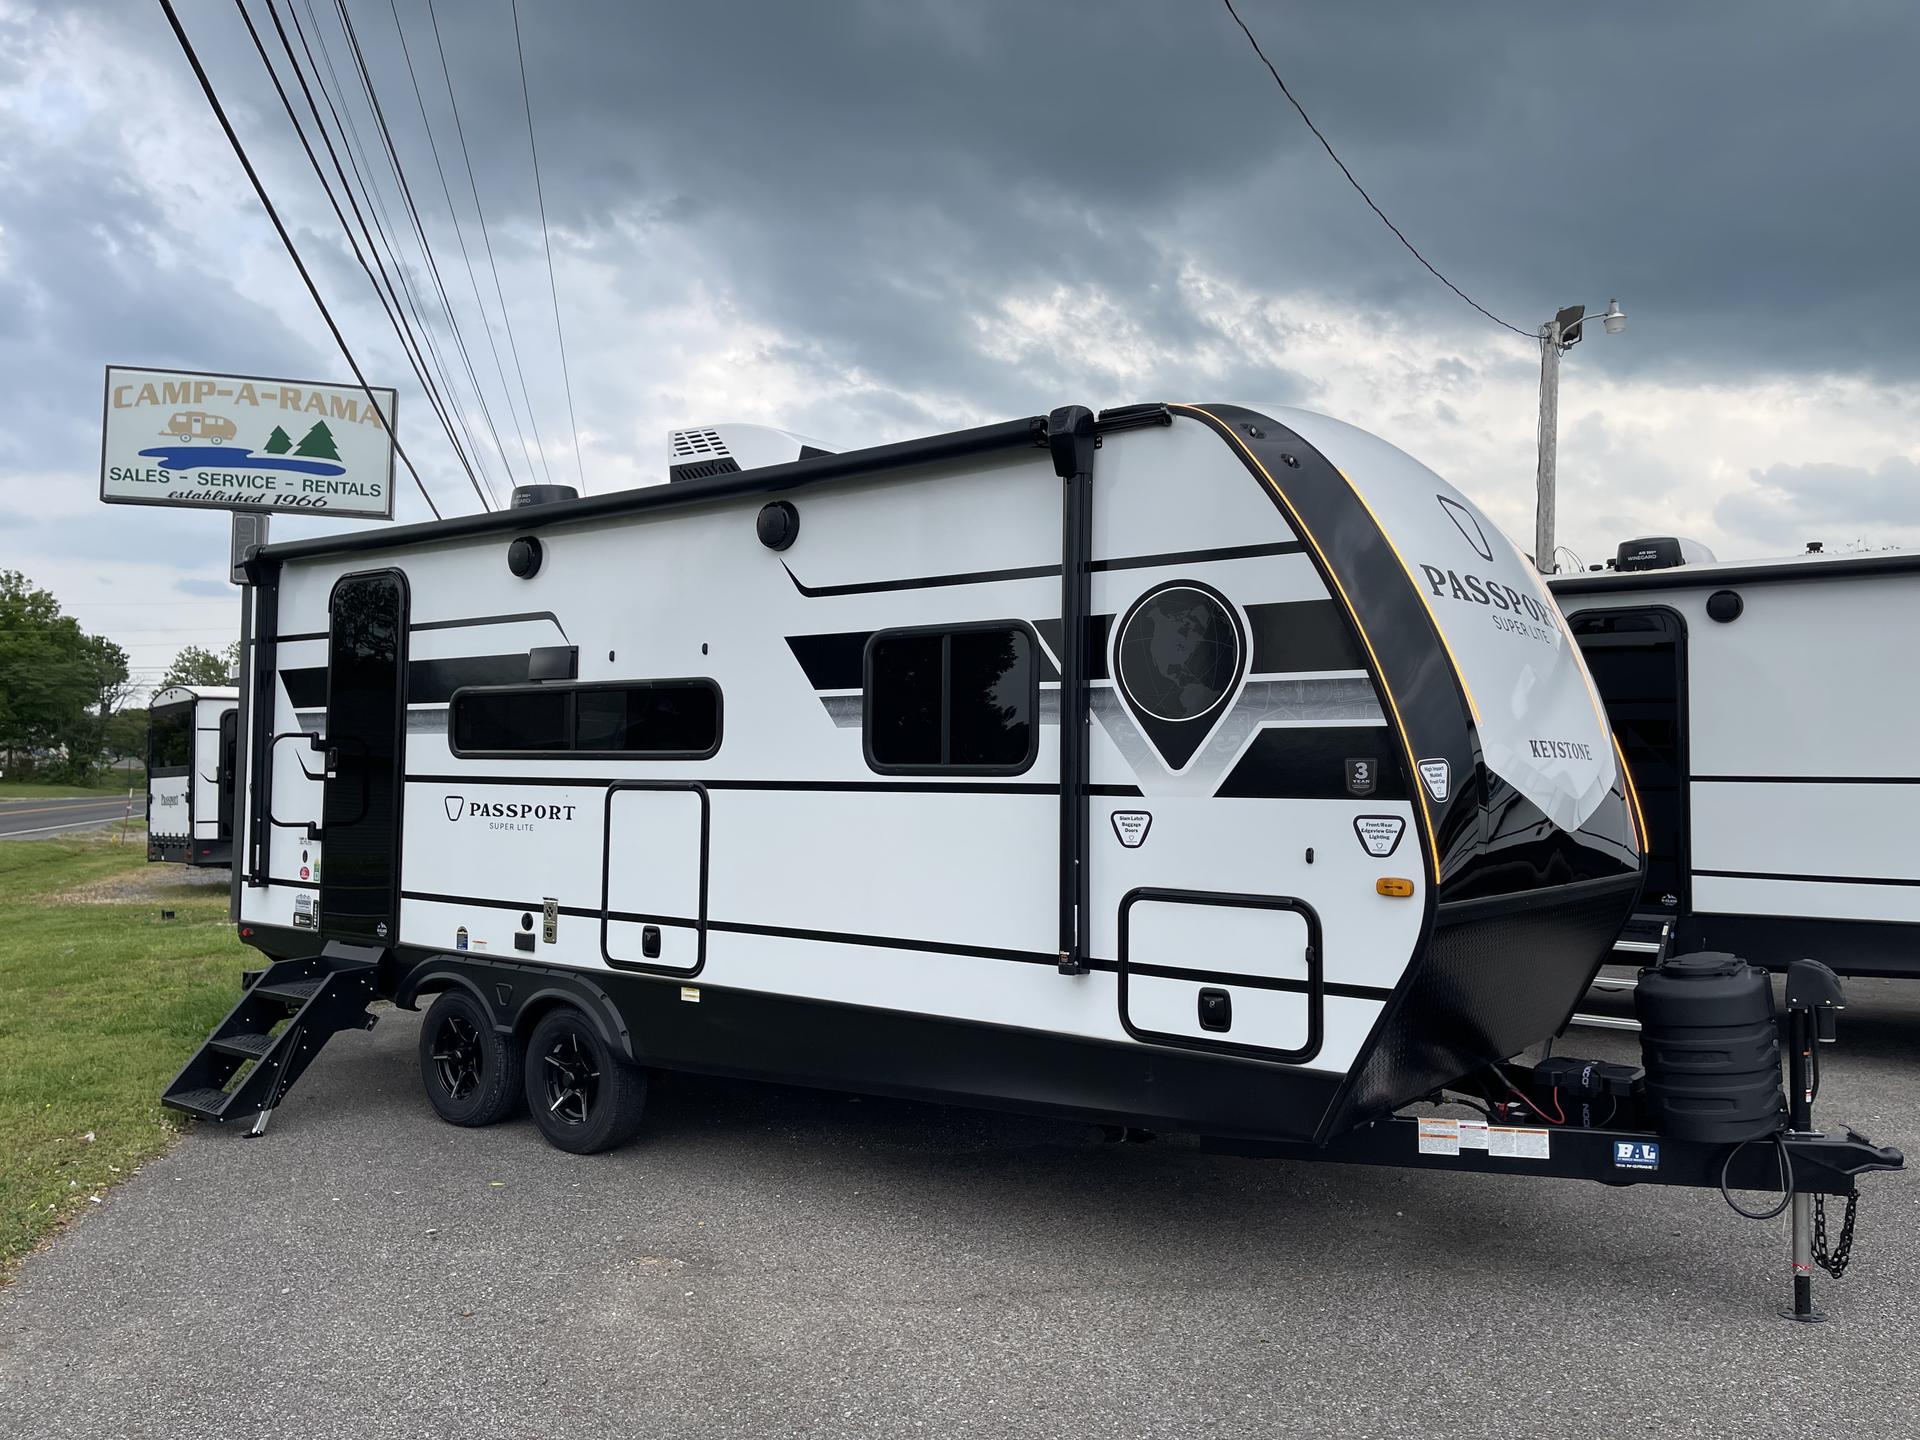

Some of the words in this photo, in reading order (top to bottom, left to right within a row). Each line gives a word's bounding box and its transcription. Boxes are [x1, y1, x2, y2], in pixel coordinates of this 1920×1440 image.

[113, 381, 383, 430] CAMP-A-RAMA
[109, 467, 170, 484] SALES
[197, 472, 277, 490] SERVICE
[302, 478, 382, 498] RENTALS
[167, 489, 266, 504] established
[273, 493, 328, 508] 1966
[1492, 615, 1528, 637] SUPER
[1529, 626, 1551, 644] LITE
[1529, 739, 1593, 761] KEYSTONE
[1355, 762, 1369, 780] 3
[469, 802, 576, 821] PASSPORT
[489, 822, 515, 831] SUPER
[516, 824, 534, 832] LITE
